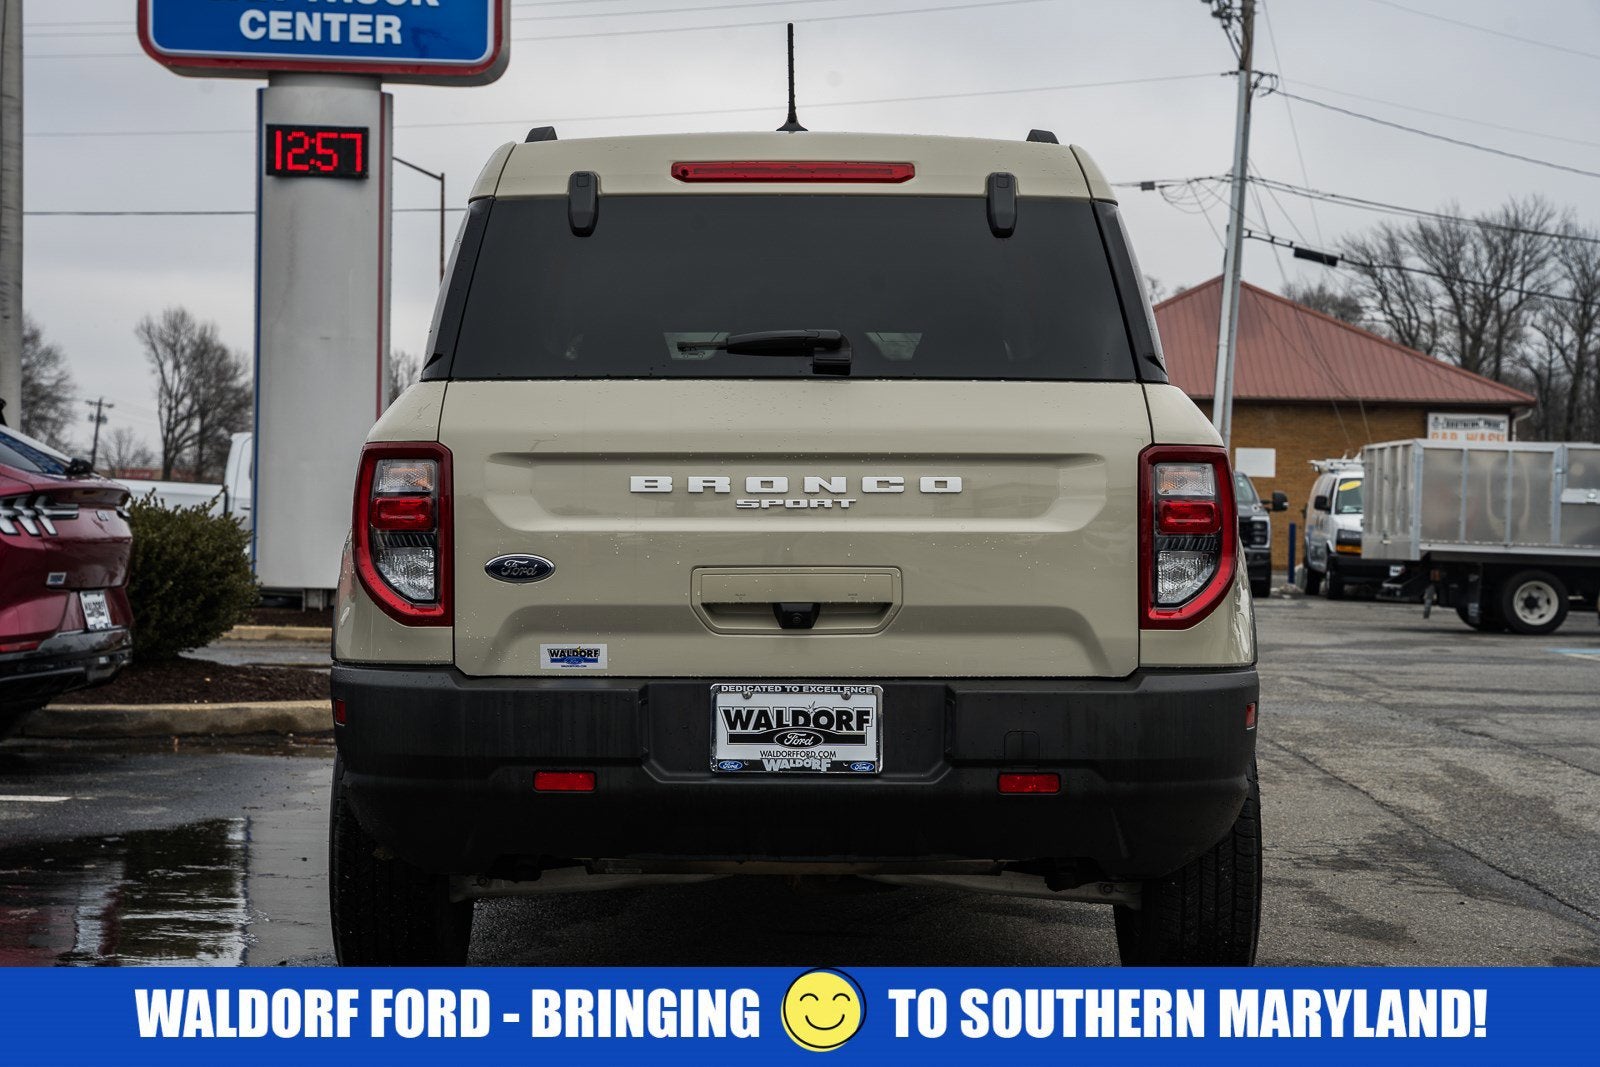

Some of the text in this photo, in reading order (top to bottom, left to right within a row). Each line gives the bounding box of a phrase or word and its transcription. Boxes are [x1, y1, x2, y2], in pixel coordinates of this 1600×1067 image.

[239, 8, 402, 45] CENTER
[275, 130, 363, 172] 12:57
[630, 476, 963, 493] BRONCO
[736, 499, 857, 509] SPORT
[500, 559, 538, 576] Ford
[547, 648, 600, 658] WALDORF
[803, 685, 873, 693] EXCELLENCE
[720, 707, 873, 731] WALDORF
[784, 733, 814, 746] Ford
[760, 750, 836, 758] WALDORFFORD.COM
[762, 758, 832, 771] WALDORF
